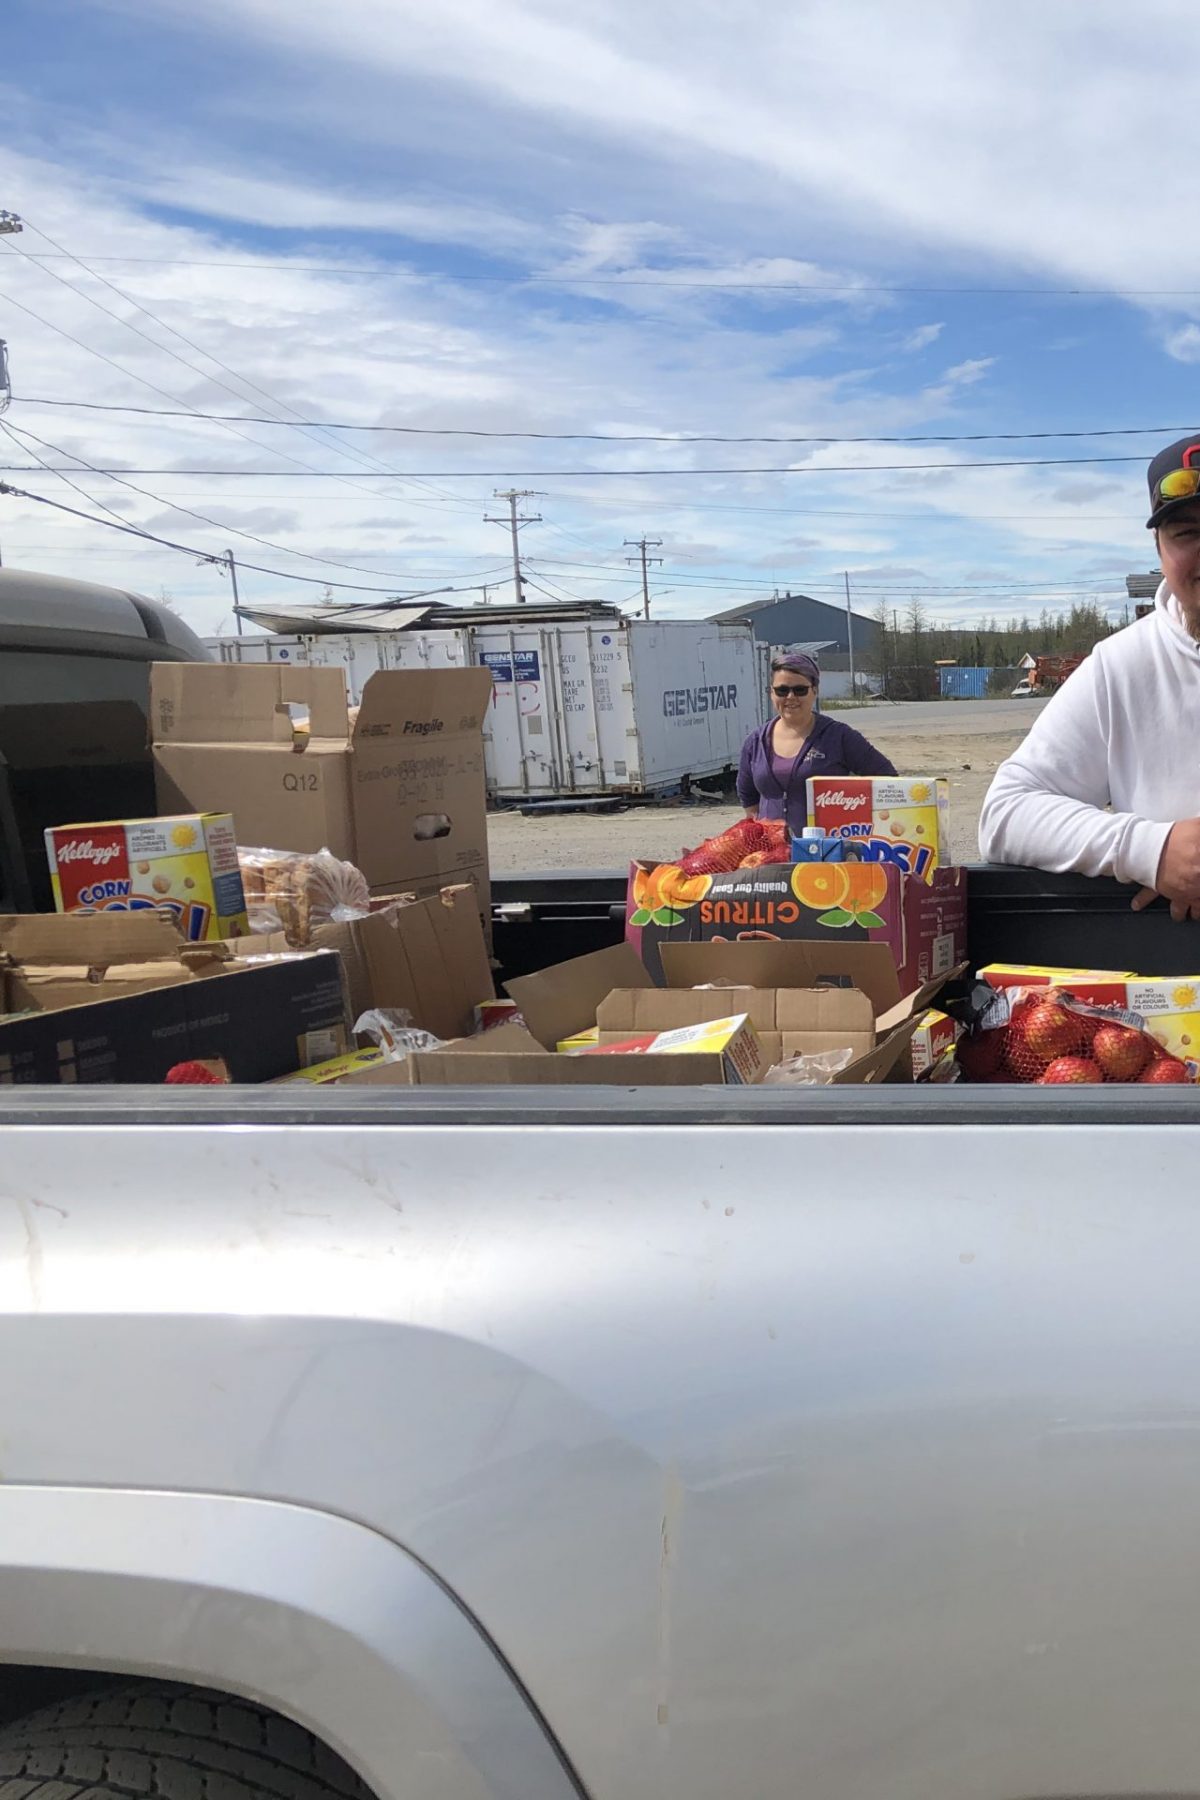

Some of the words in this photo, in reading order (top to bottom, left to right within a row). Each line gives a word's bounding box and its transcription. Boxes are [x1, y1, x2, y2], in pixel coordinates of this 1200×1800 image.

[663, 684, 737, 717] GENSTAR
[403, 719, 444, 736] Fragile
[283, 773, 318, 791] Q12
[816, 790, 868, 810] Kellogg's
[831, 824, 873, 838] CORN
[58, 840, 120, 865] Kellogg's
[80, 881, 131, 904] CORN
[712, 884, 734, 894] Goal
[734, 883, 752, 893] Our
[753, 881, 788, 893] Quality
[701, 901, 800, 924] CITRUS
